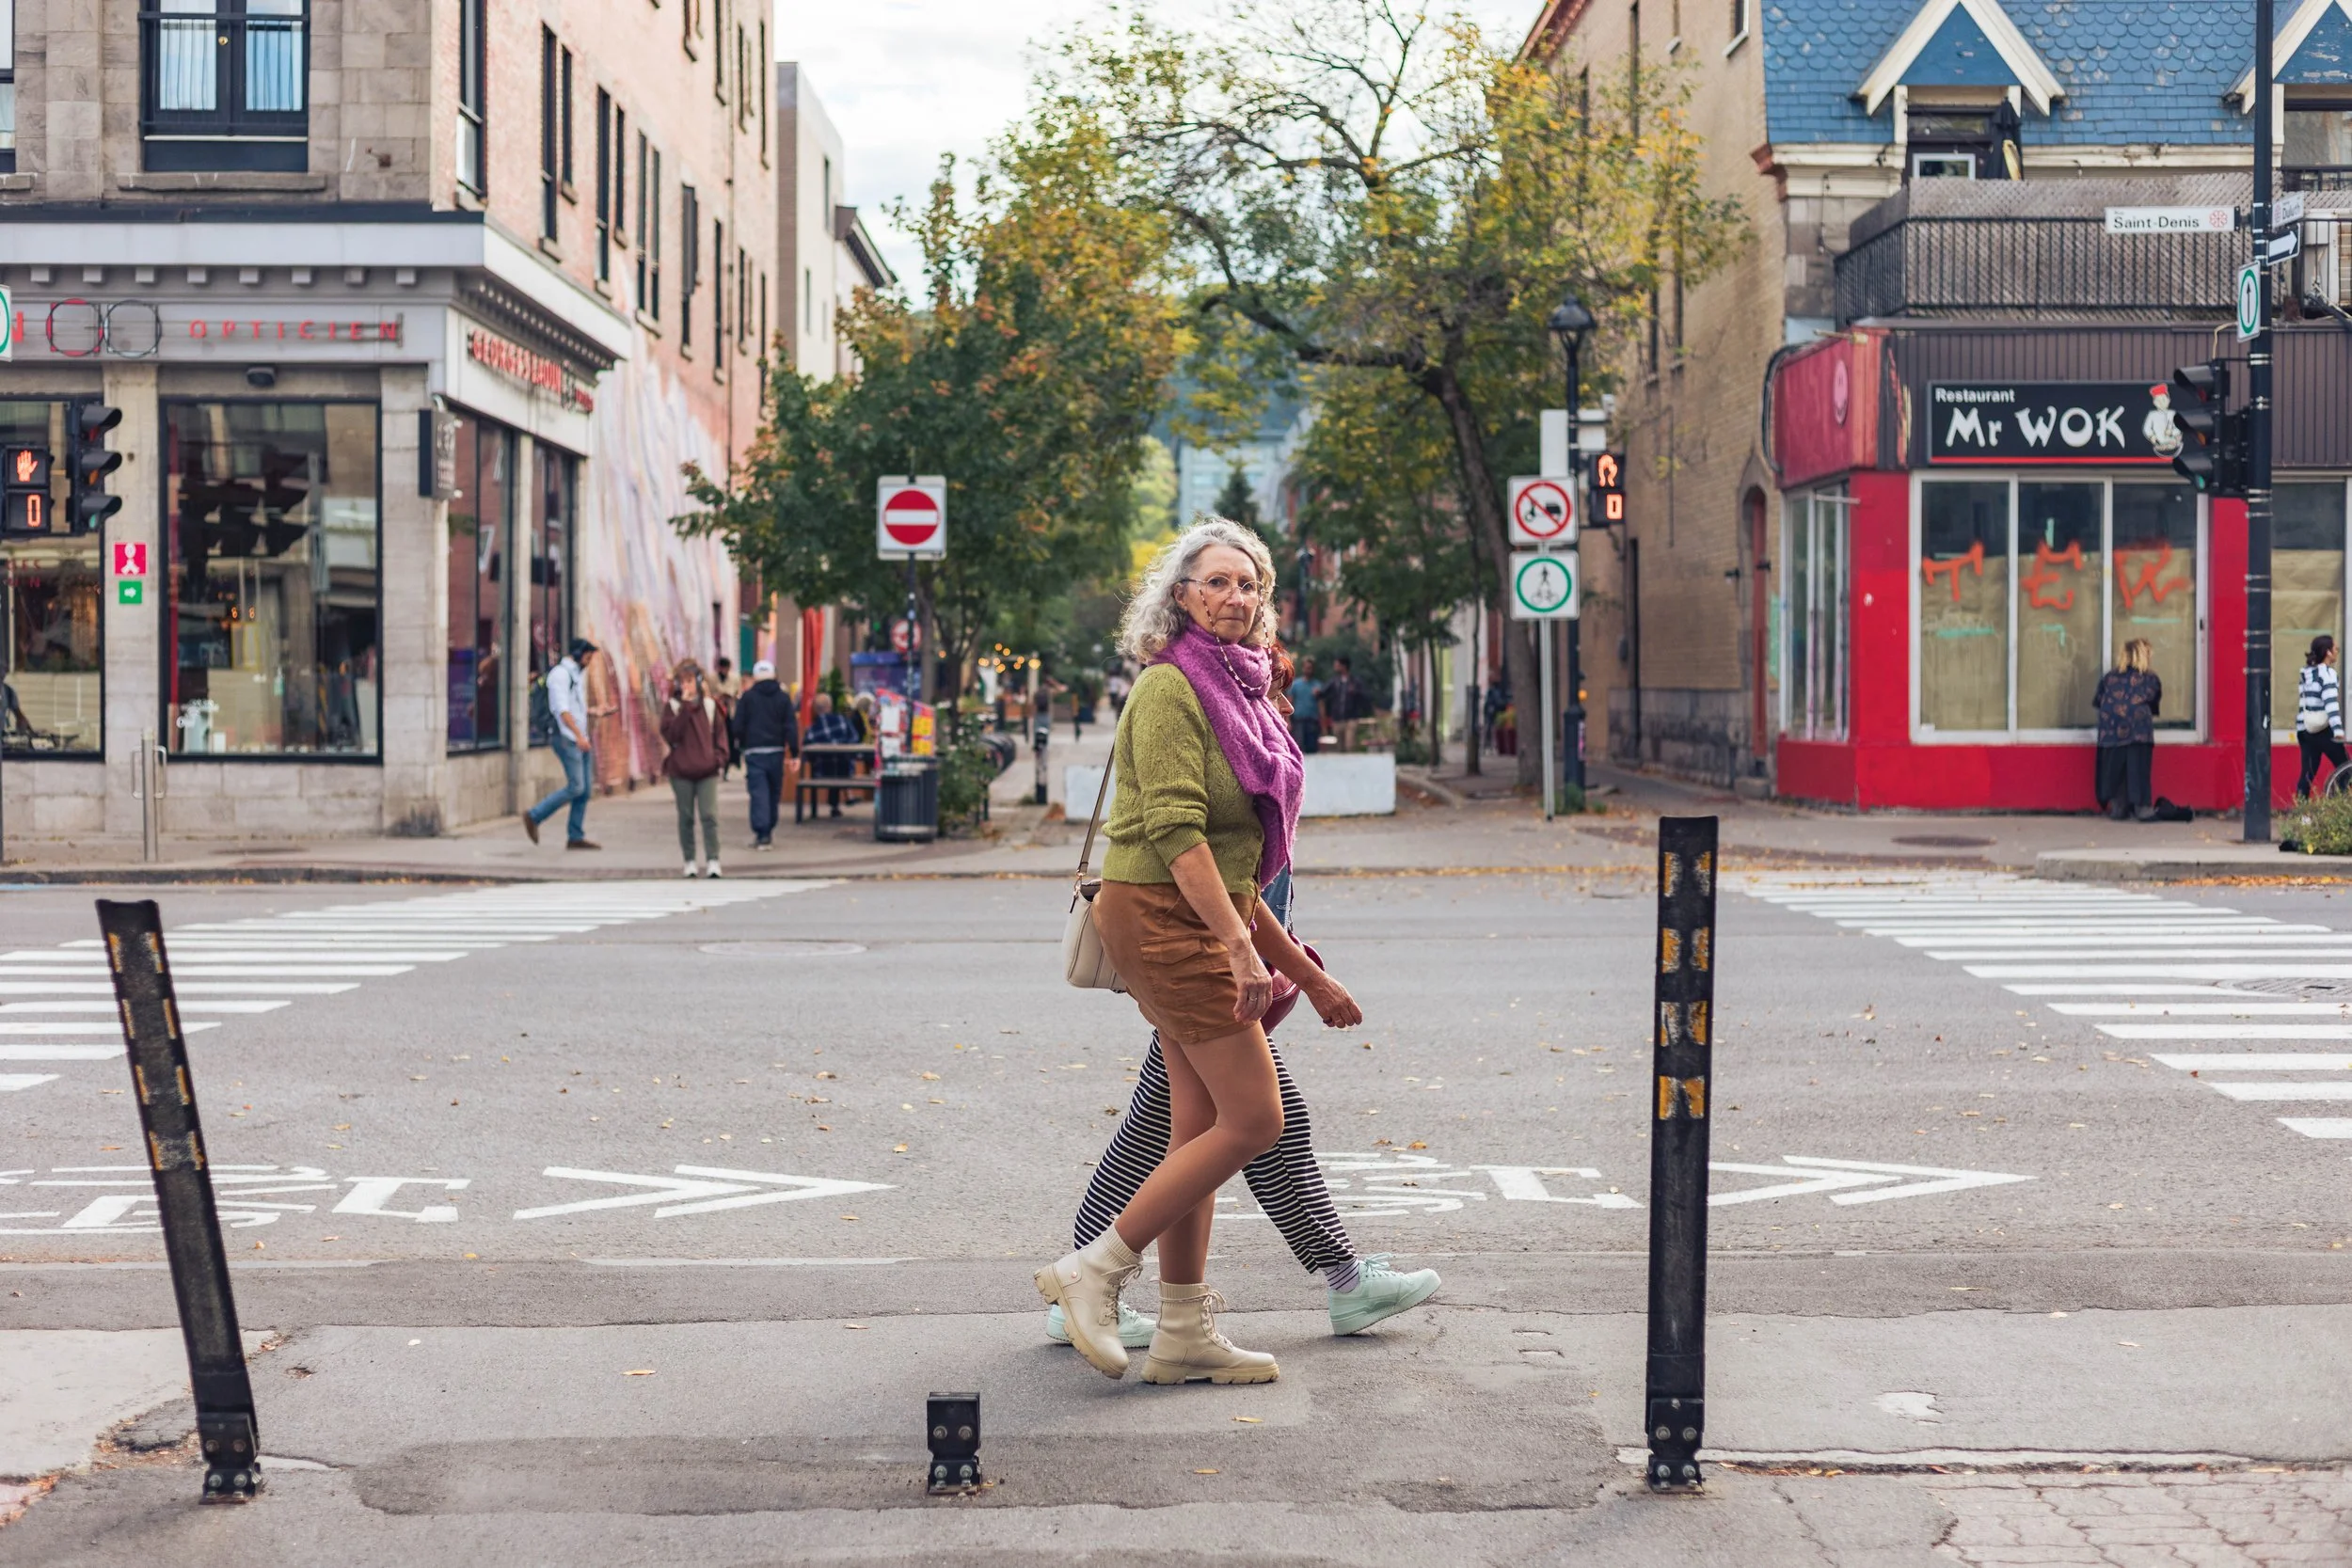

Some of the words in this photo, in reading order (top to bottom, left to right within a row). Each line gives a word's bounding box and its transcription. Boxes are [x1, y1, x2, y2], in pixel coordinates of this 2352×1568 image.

[2113, 214, 2200, 229] Saint-Denis
[189, 319, 399, 341] OPTICIEN
[1935, 388, 2015, 404] Restaurant
[1946, 406, 2002, 448] Mr
[2014, 404, 2125, 450] WOK
[26, 494, 41, 528] 0
[1606, 493, 1623, 520] 0
